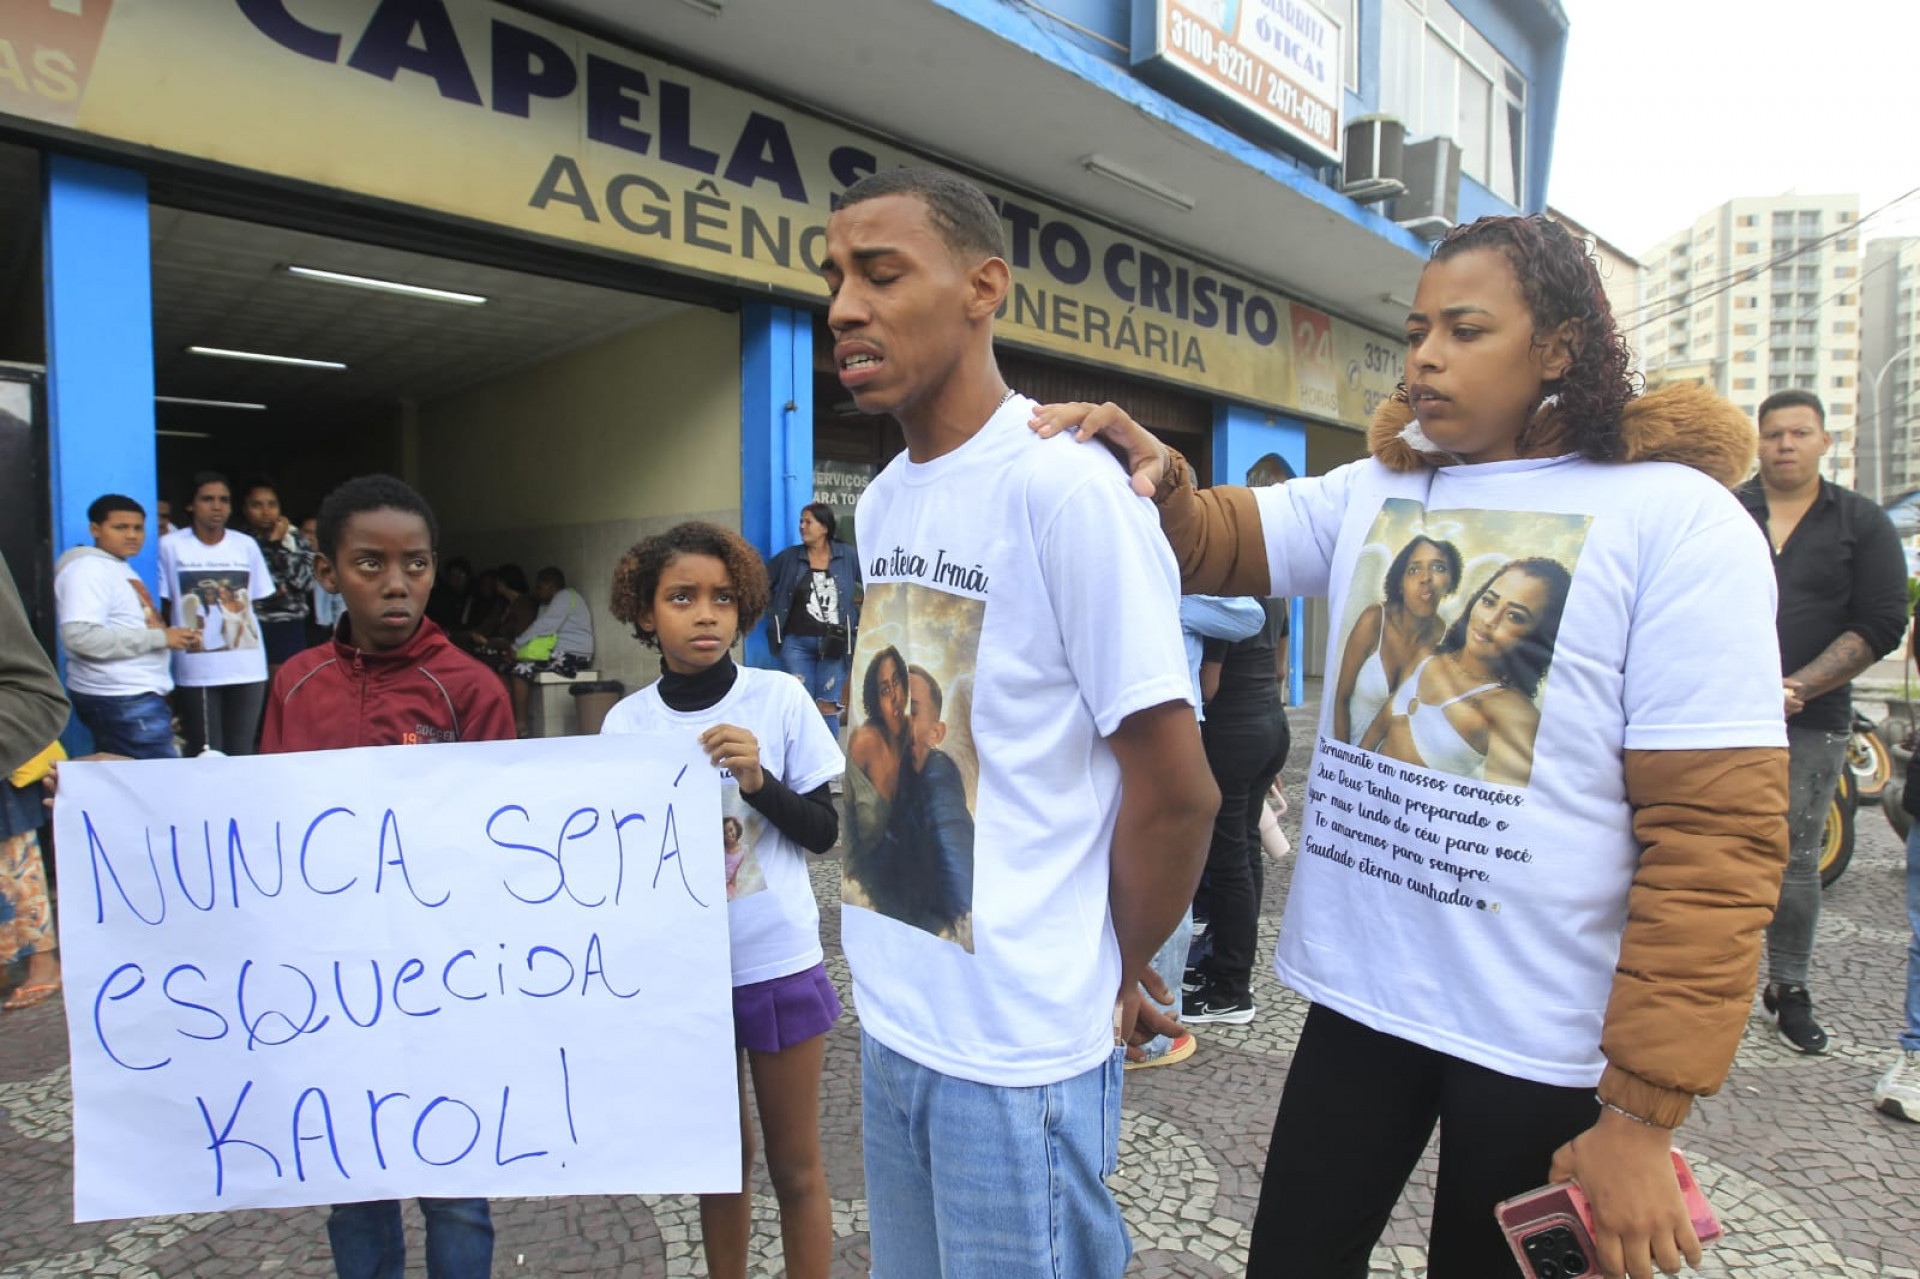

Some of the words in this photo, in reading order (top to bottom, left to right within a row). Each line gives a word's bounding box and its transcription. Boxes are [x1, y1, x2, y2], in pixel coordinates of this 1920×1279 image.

[1171, 9, 1253, 91] 3100-6271
[1267, 72, 1333, 141] 2471-4789
[1256, 14, 1325, 82] ÓTICAS
[829, 146, 1091, 285] STO
[1103, 242, 1278, 346] CRISTO
[994, 283, 1206, 374] NERÁRIA
[1298, 320, 1330, 370] 24
[1301, 385, 1337, 412] HORAS
[1339, 769, 1363, 793] Deus
[1365, 780, 1402, 806] tenha
[1405, 798, 1491, 828] preparado
[1496, 820, 1510, 831] o
[1378, 762, 1396, 777] em
[1400, 769, 1448, 791] nossos
[1315, 811, 1328, 828] Te
[1331, 820, 1388, 850] amaremos
[1392, 844, 1424, 865] para
[1331, 796, 1354, 813] mais
[1359, 802, 1391, 826] lindo
[1394, 816, 1410, 834] do
[1415, 827, 1440, 844] céu
[1445, 836, 1489, 855] para
[81, 807, 450, 926] NUNCA
[1306, 834, 1356, 869] Saudade
[1359, 857, 1403, 886] eterna
[1406, 877, 1473, 909] cunhada
